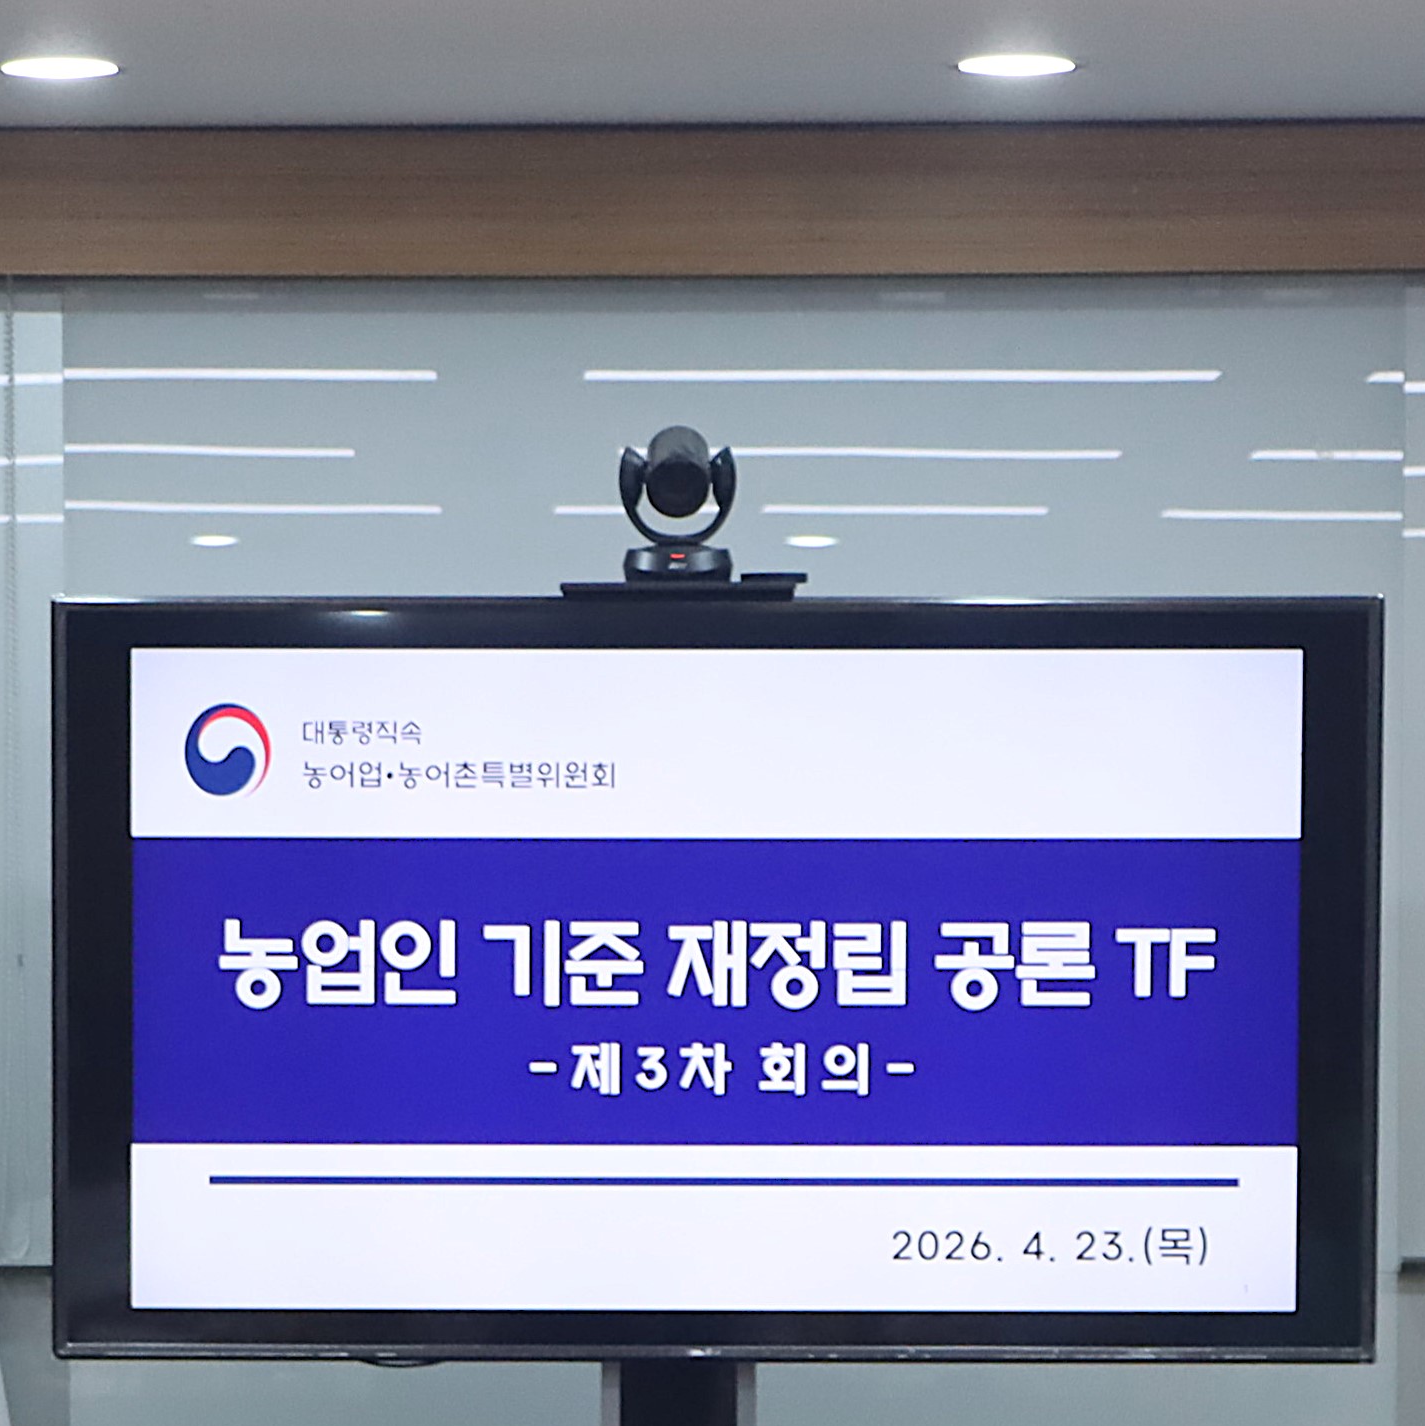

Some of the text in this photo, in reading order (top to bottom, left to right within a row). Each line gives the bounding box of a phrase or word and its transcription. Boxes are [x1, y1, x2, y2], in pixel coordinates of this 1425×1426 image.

[302, 720, 422, 746] 대통령직속
[218, 918, 1216, 1011] 농업인 기준 재정립 공론 TF
[892, 1226, 1209, 1267] 2026. 4. 23.(목)
